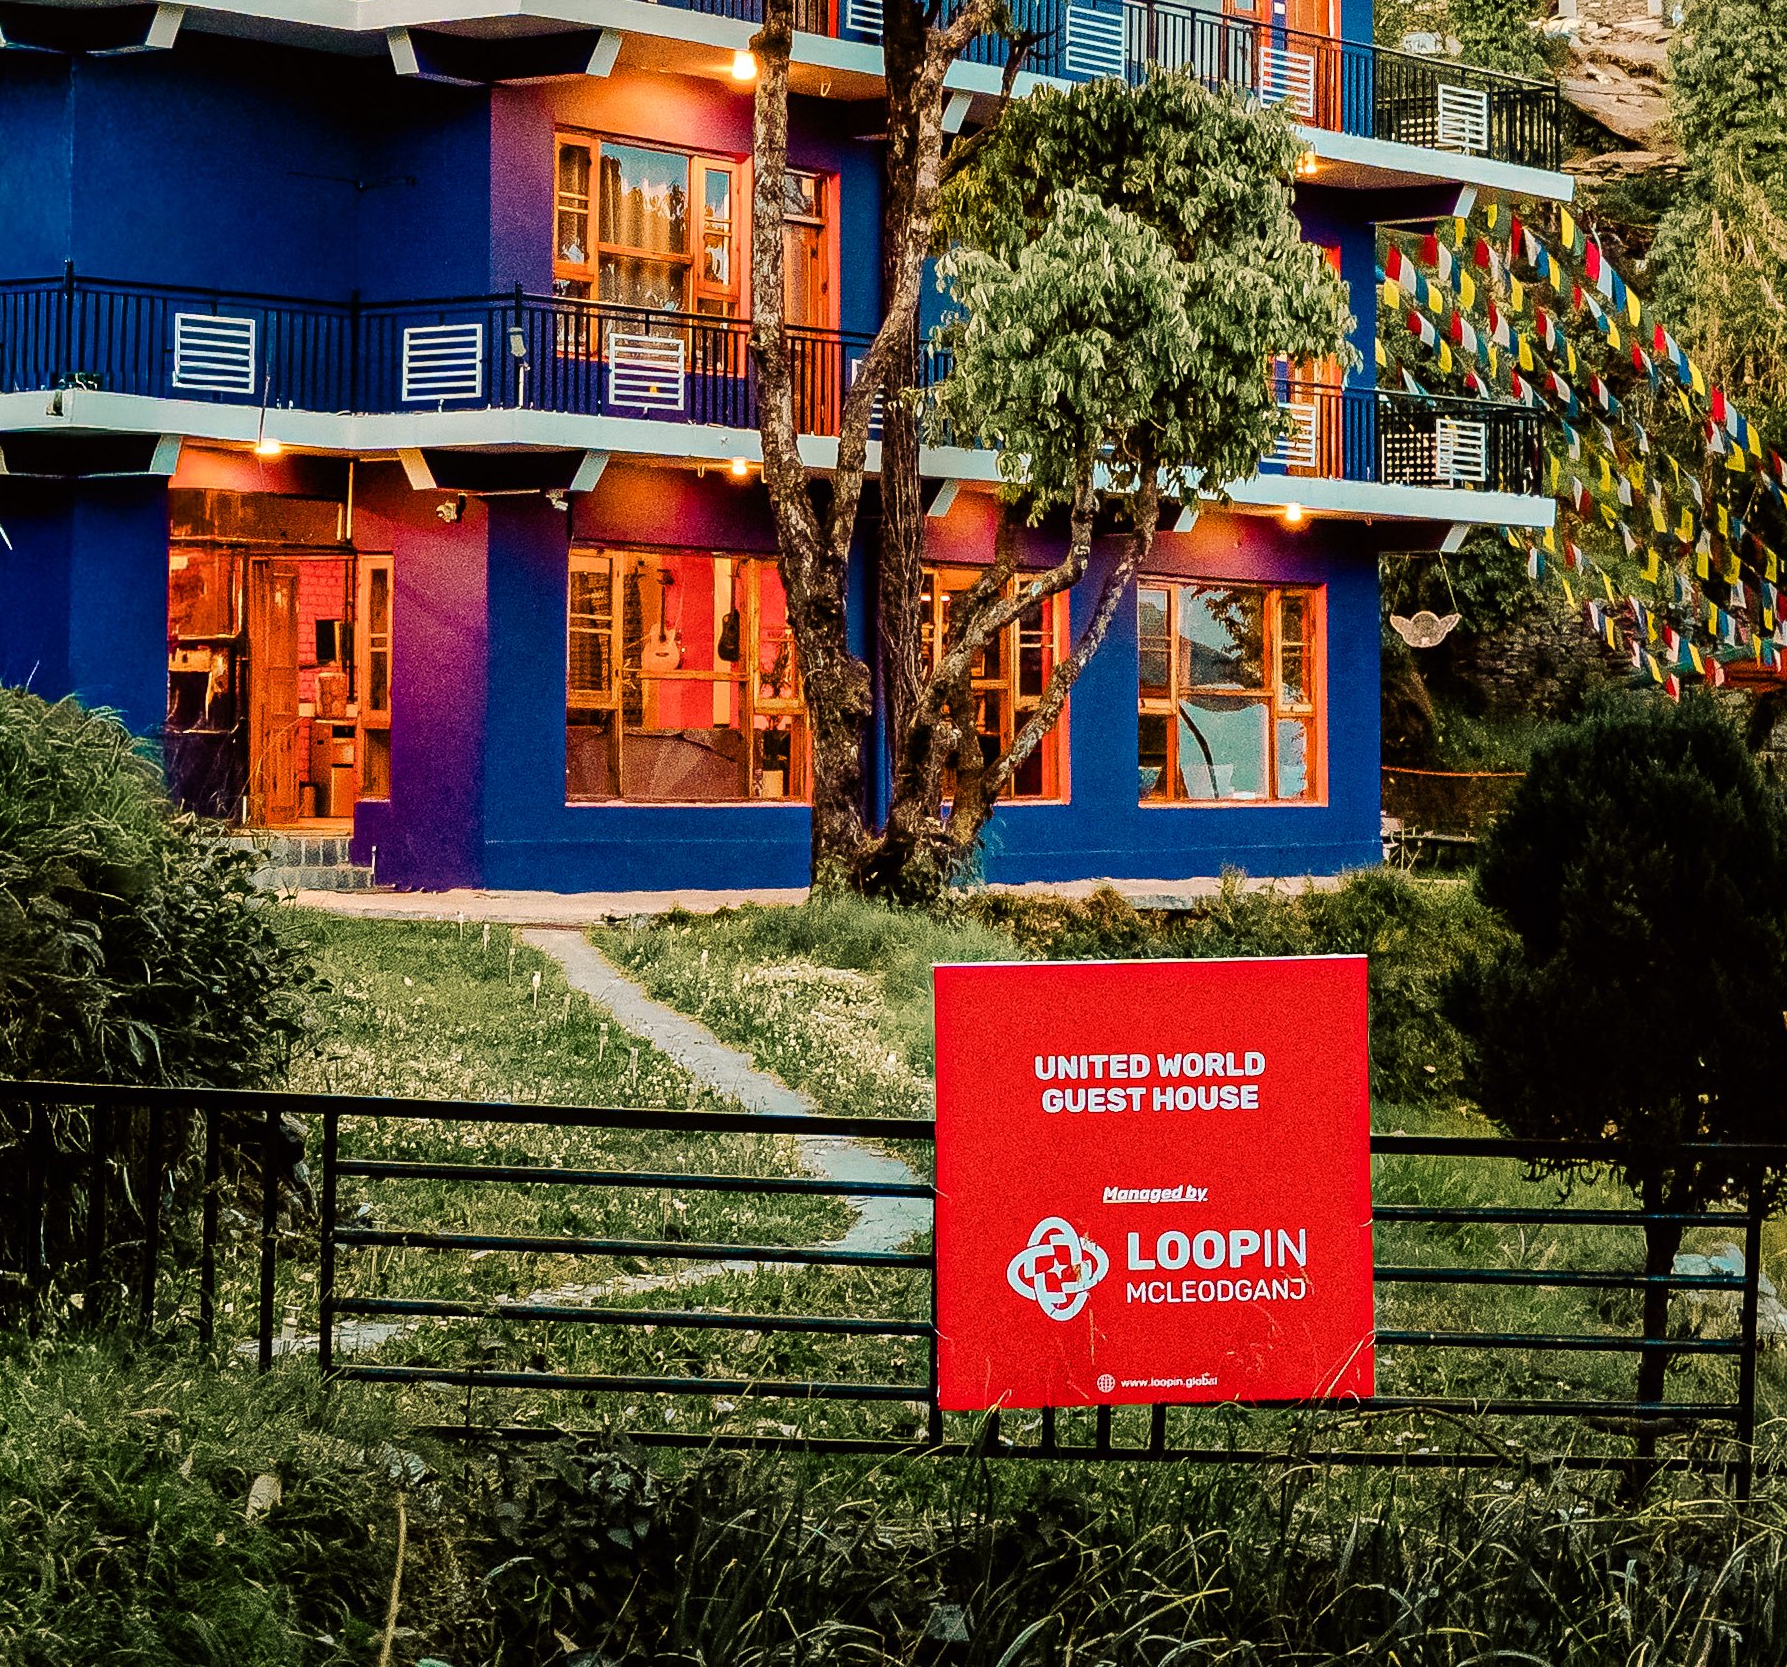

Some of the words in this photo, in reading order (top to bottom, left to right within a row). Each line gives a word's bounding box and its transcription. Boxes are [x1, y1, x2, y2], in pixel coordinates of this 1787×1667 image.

[1034, 1054, 1151, 1080] UNITED
[1156, 1051, 1266, 1078] WORLD
[1041, 1087, 1147, 1113] GUEST
[1152, 1085, 1259, 1111] HOUSE
[1102, 1185, 1184, 1203] Managed
[1185, 1184, 1208, 1202] by
[1127, 1228, 1307, 1269] LOOPIN
[1126, 1278, 1307, 1303] MCLEODGANJ
[1120, 1375, 1218, 1389] www.loopin.global
